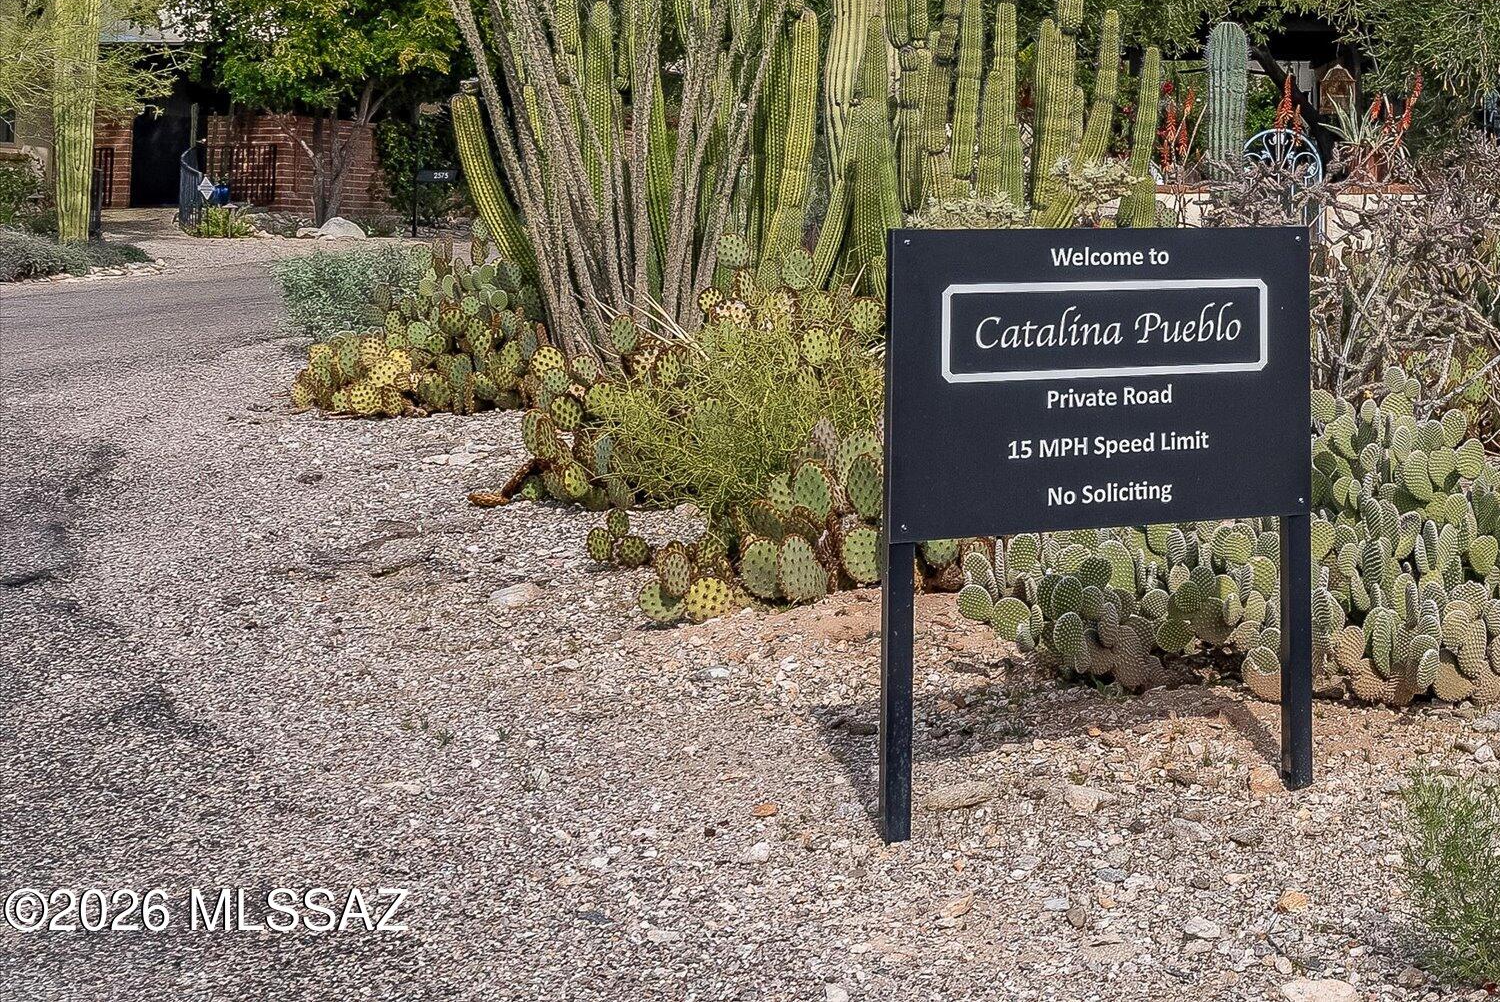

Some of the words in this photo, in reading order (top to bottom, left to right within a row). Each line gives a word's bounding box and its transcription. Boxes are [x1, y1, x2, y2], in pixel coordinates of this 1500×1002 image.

[1051, 247, 1143, 266] Welcome
[1148, 248, 1169, 265] to
[976, 306, 1123, 349] Catalina
[1135, 302, 1241, 343] Pueblo
[1047, 388, 1117, 408] Private
[1124, 384, 1172, 405] Road
[1008, 440, 1032, 459] 15
[1039, 437, 1088, 458] MPH
[1094, 432, 1154, 458] Speed
[1161, 431, 1209, 450] Limit
[1048, 487, 1077, 506] No
[1082, 481, 1172, 503] Soliciting
